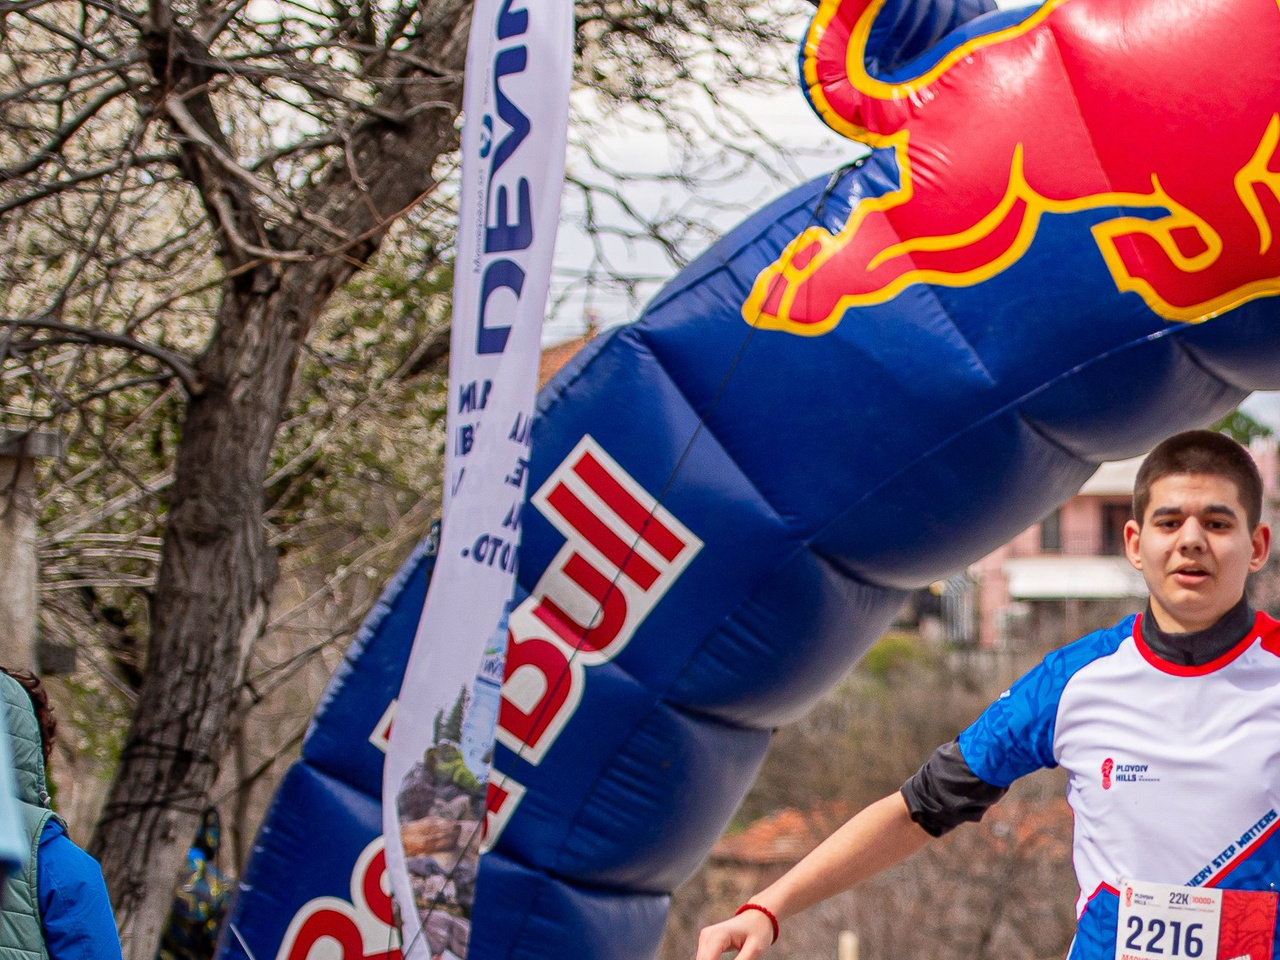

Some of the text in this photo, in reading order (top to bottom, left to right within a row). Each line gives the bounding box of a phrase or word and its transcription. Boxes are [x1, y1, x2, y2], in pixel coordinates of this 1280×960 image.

[1116, 764, 1149, 772] PLOVDIV
[1115, 774, 1137, 782] HILLS
[1211, 844, 1237, 869] STEP
[1235, 808, 1278, 849] MATTERS
[1169, 891, 1190, 906] 22K
[1125, 915, 1204, 959] 2216
